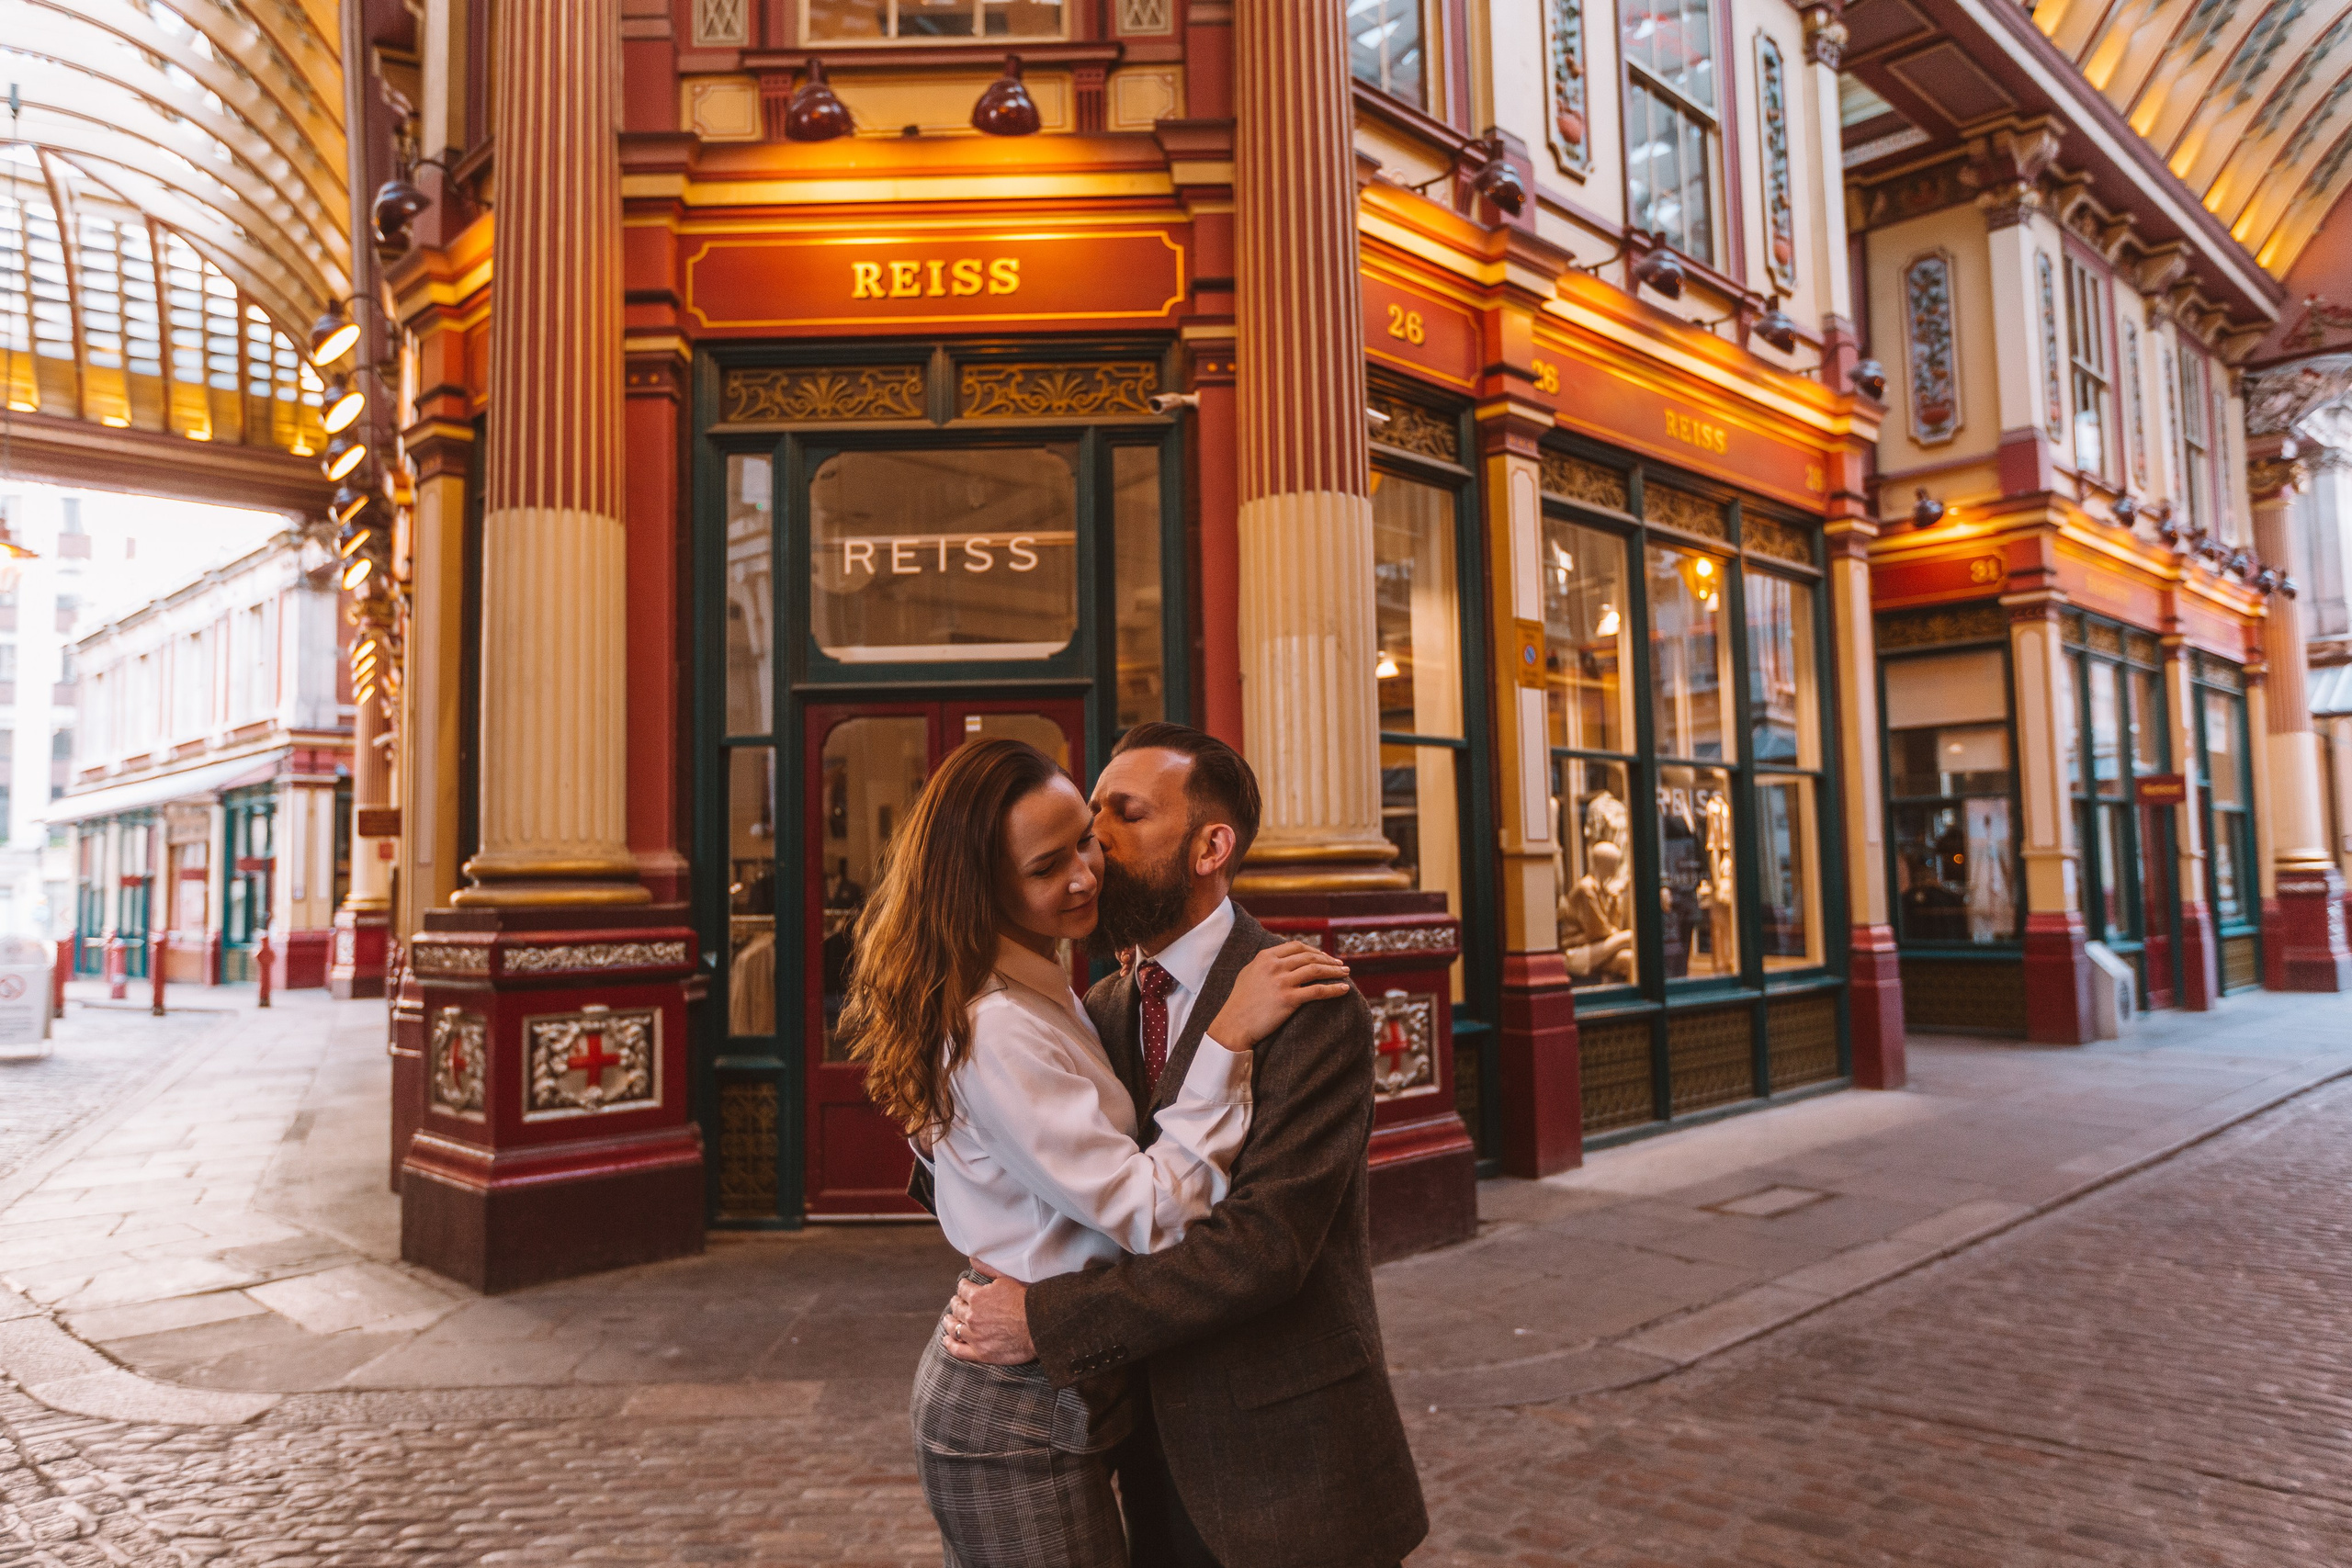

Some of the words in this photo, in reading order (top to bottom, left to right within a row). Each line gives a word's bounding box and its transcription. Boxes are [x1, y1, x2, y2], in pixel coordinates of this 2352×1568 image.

[851, 257, 1021, 299] REISS
[1386, 303, 1425, 344] 26
[1531, 358, 1560, 394] 26
[1664, 408, 1728, 456] REISS
[843, 536, 1038, 575] REISS
[1656, 787, 1724, 817] REIS
